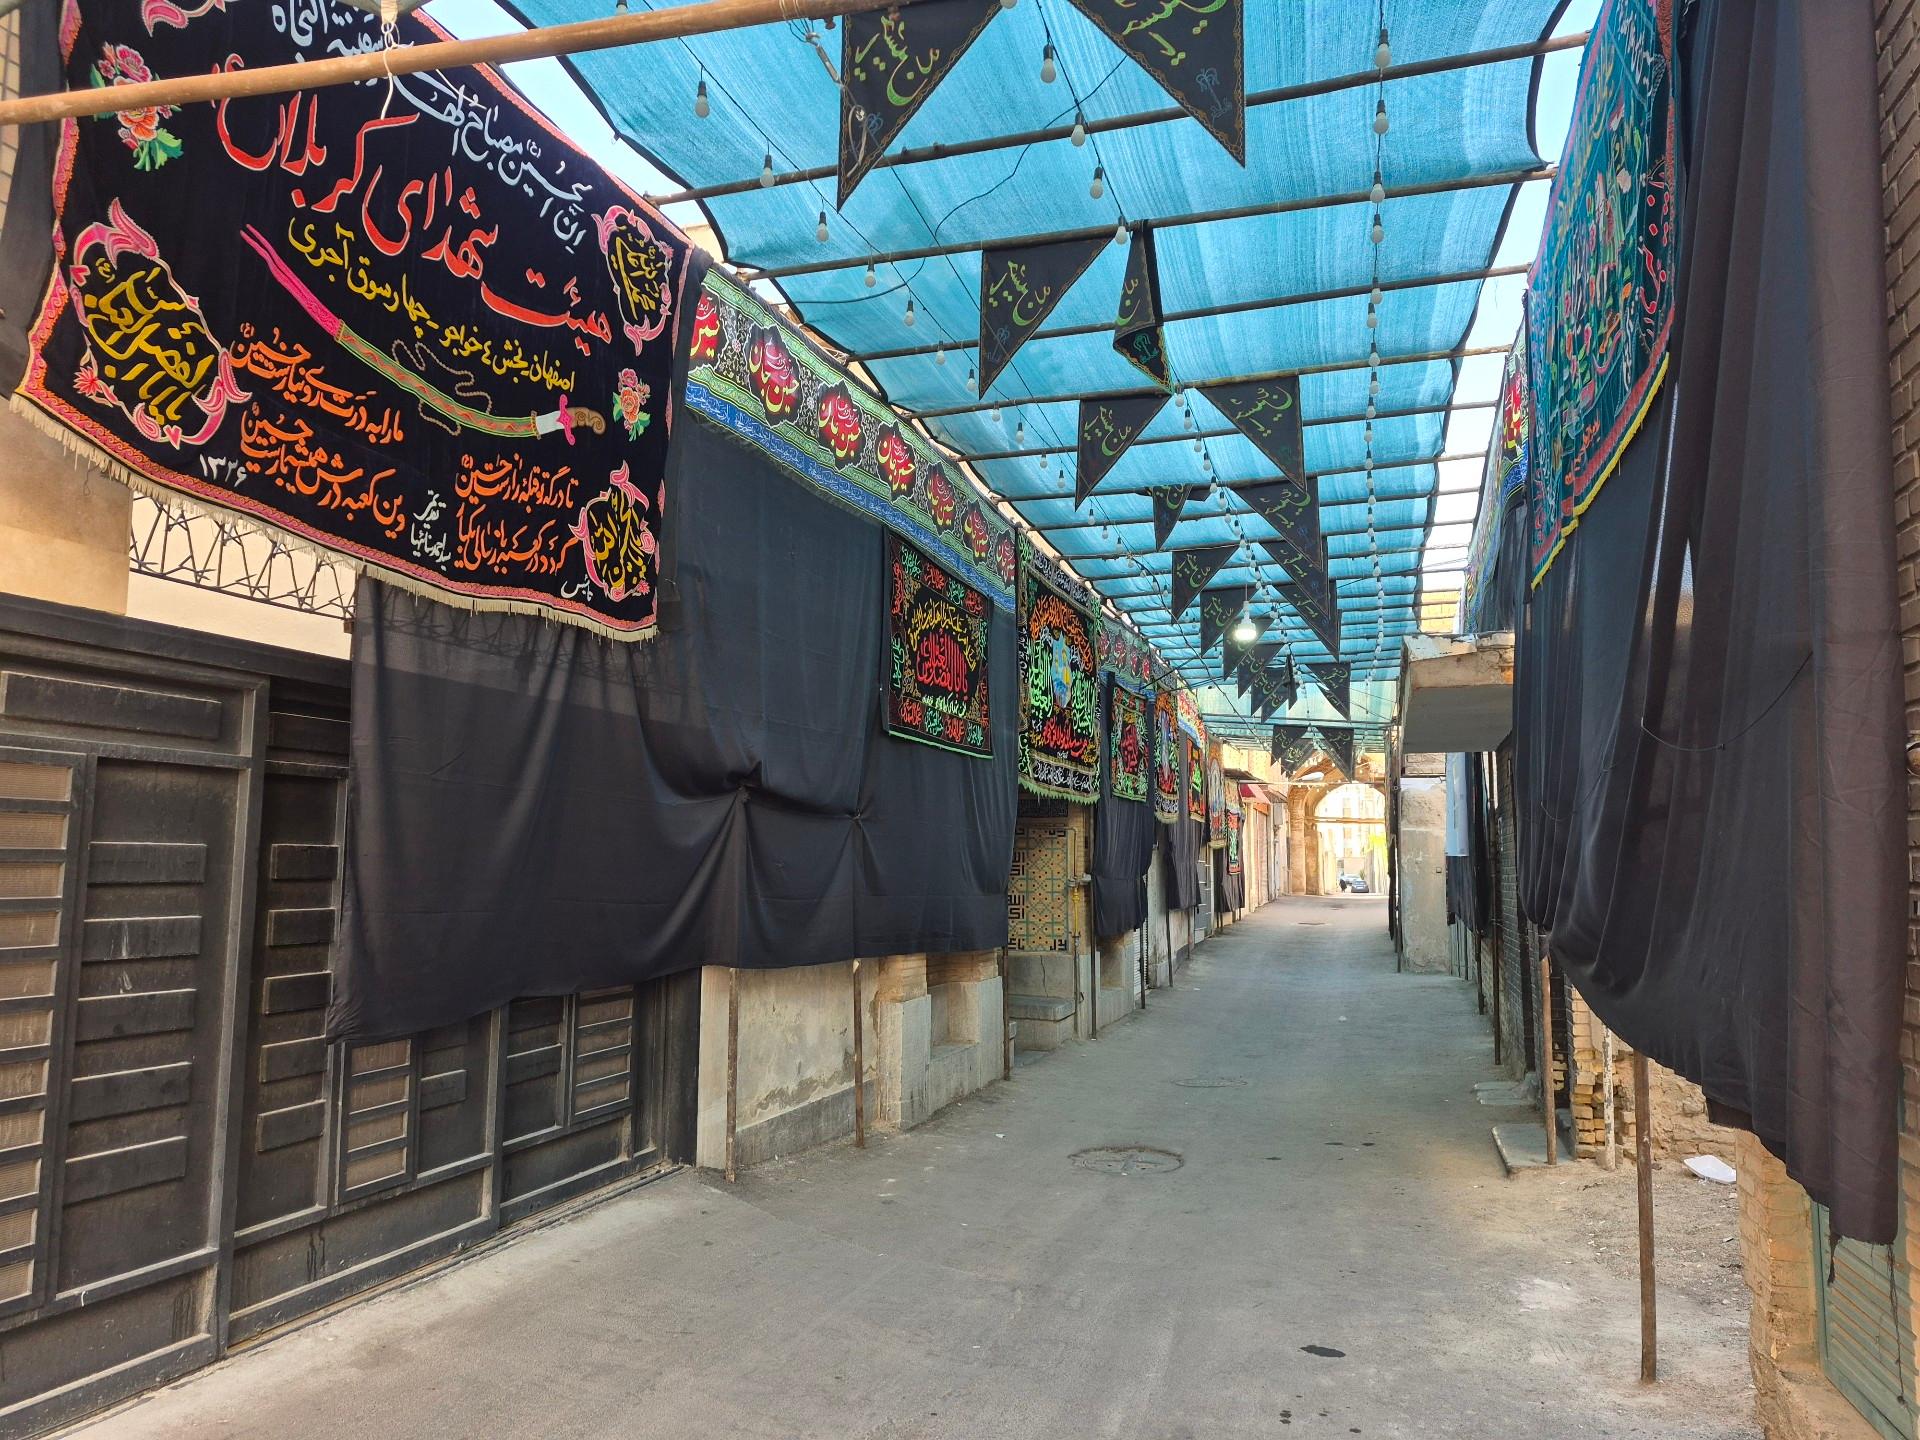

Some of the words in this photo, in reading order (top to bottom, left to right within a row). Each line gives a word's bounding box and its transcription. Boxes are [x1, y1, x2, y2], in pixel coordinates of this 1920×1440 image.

[288, 216, 355, 283] آجری
[529, 349, 576, 392] اصفهان
[748, 343, 773, 397] جان
[765, 379, 801, 414] حسین
[892, 462, 916, 492] حسین
